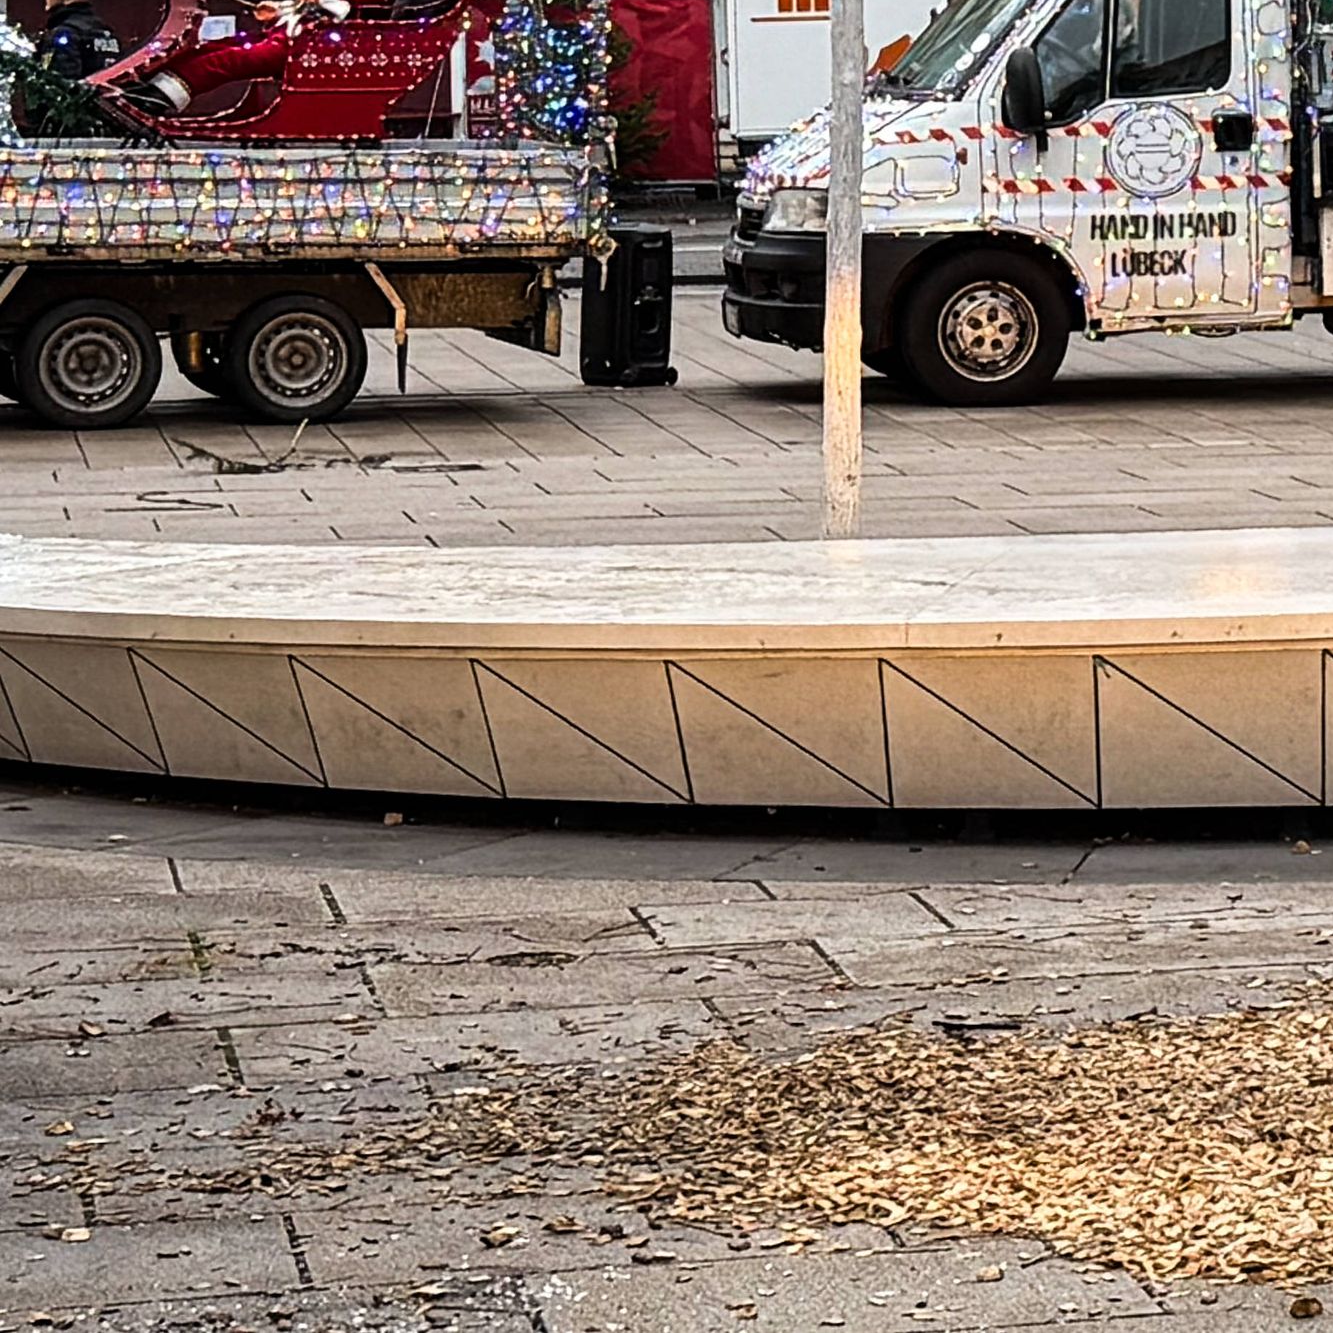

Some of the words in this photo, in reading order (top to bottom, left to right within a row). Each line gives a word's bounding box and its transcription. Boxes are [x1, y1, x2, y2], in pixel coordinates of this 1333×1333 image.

[1091, 213, 1149, 241] HAND
[1152, 212, 1175, 240] IN
[1179, 210, 1237, 239] HAND
